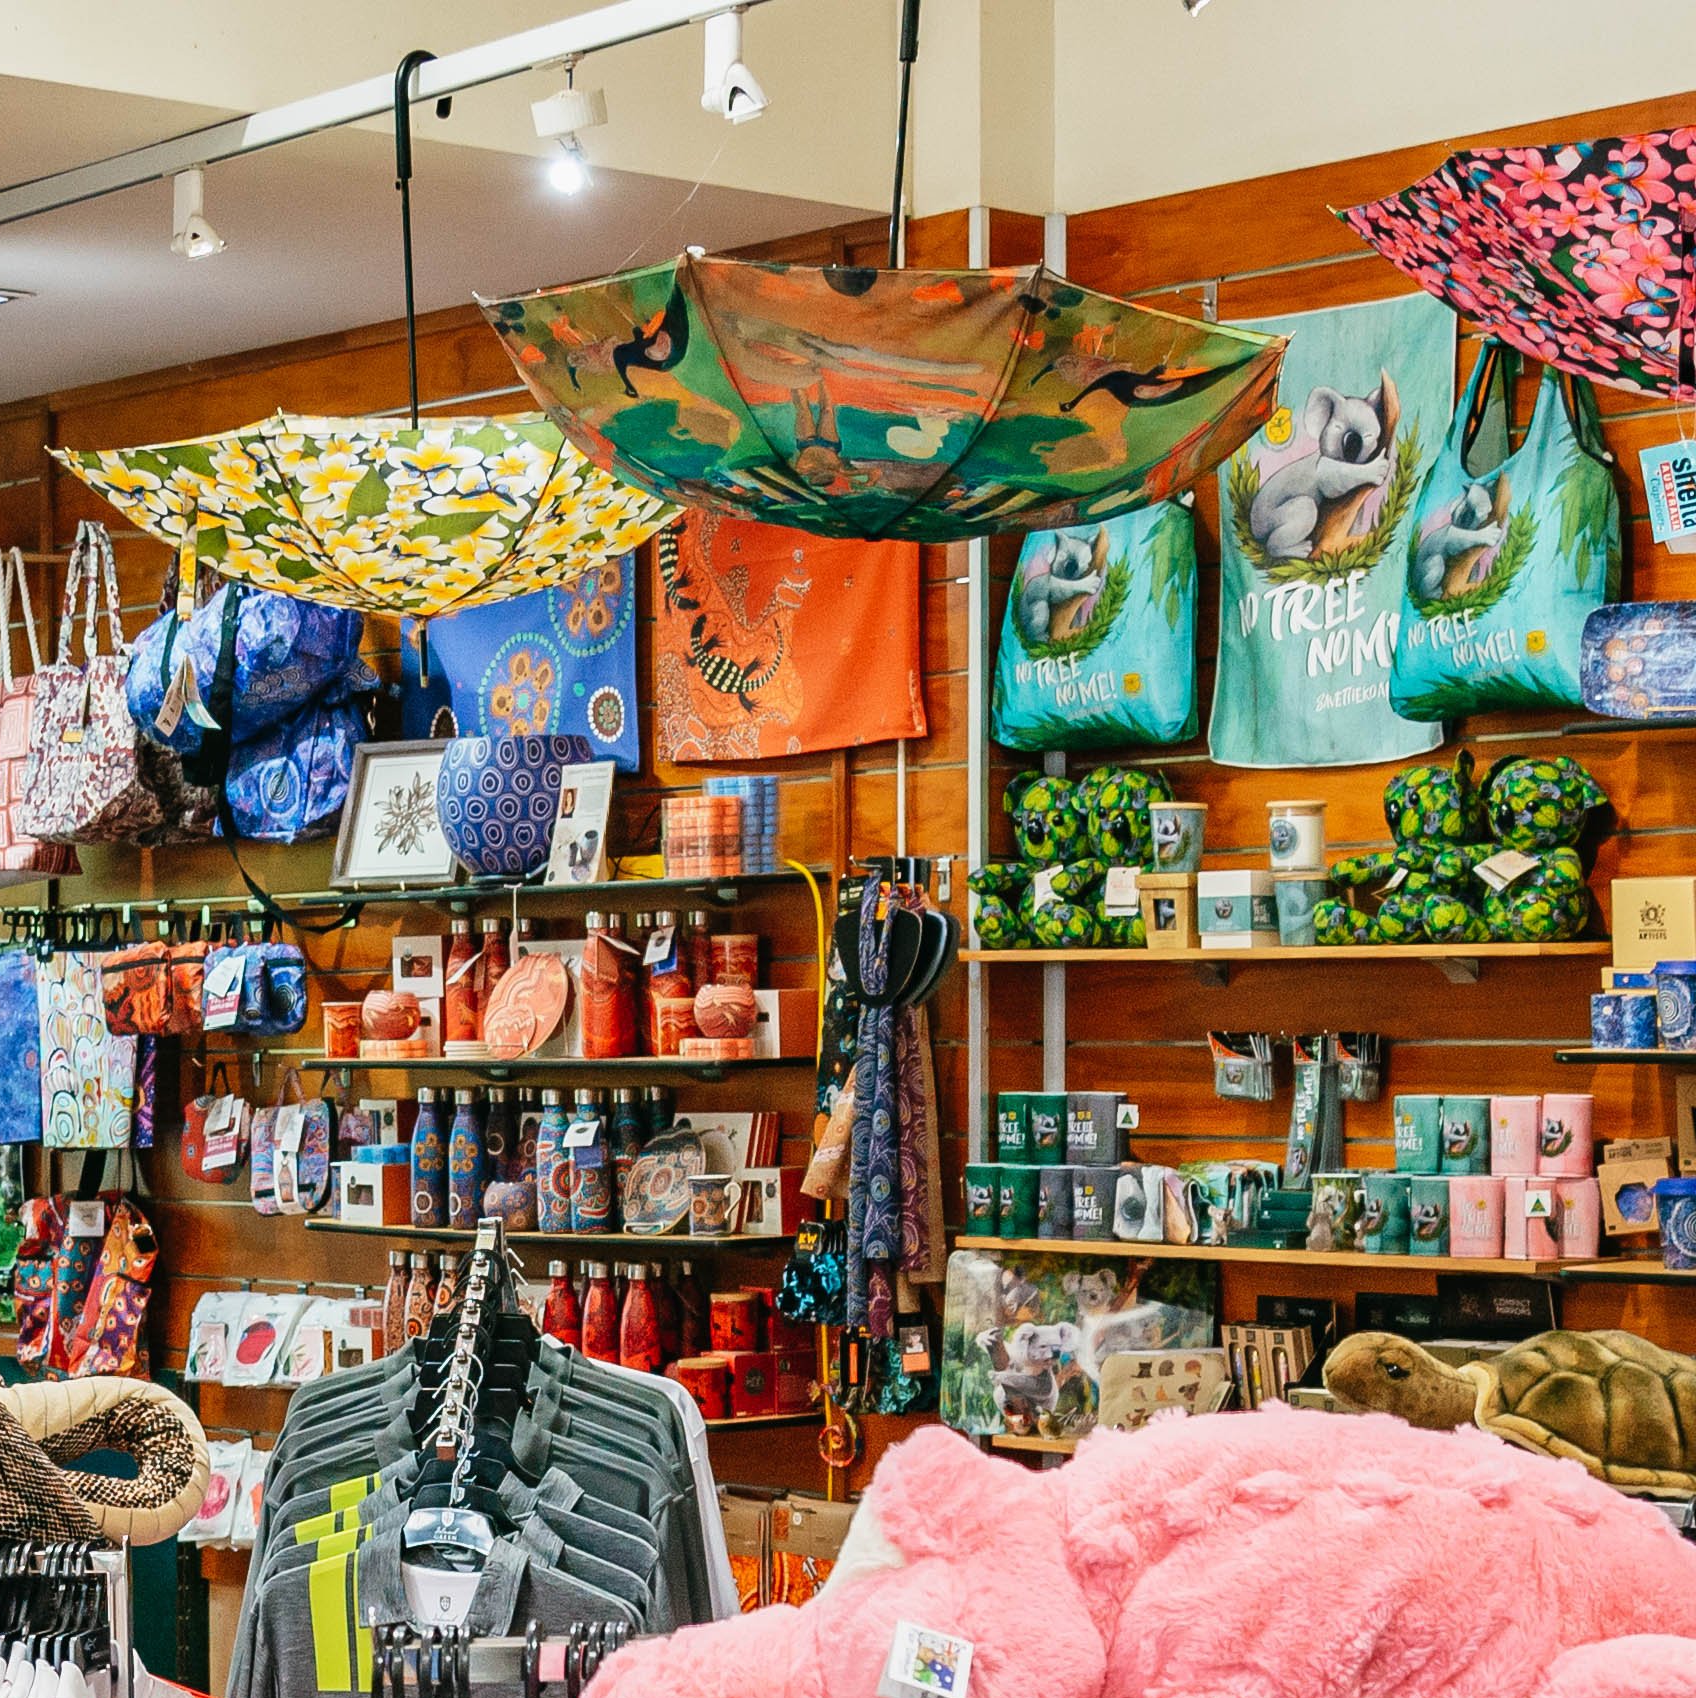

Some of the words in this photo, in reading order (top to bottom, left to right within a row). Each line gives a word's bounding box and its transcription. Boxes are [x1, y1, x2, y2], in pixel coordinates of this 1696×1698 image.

[1239, 592, 1258, 637] NO
[1264, 570, 1366, 641] TREE
[1408, 627, 1426, 649] NO
[1427, 608, 1478, 650] TREE
[1452, 642, 1474, 668] NO
[1477, 629, 1520, 667] ME!
[1016, 662, 1032, 684] NO
[1033, 651, 1082, 688] TREE
[1307, 629, 1350, 678] NO
[1056, 681, 1076, 707] NO
[1078, 670, 1118, 705] ME!
